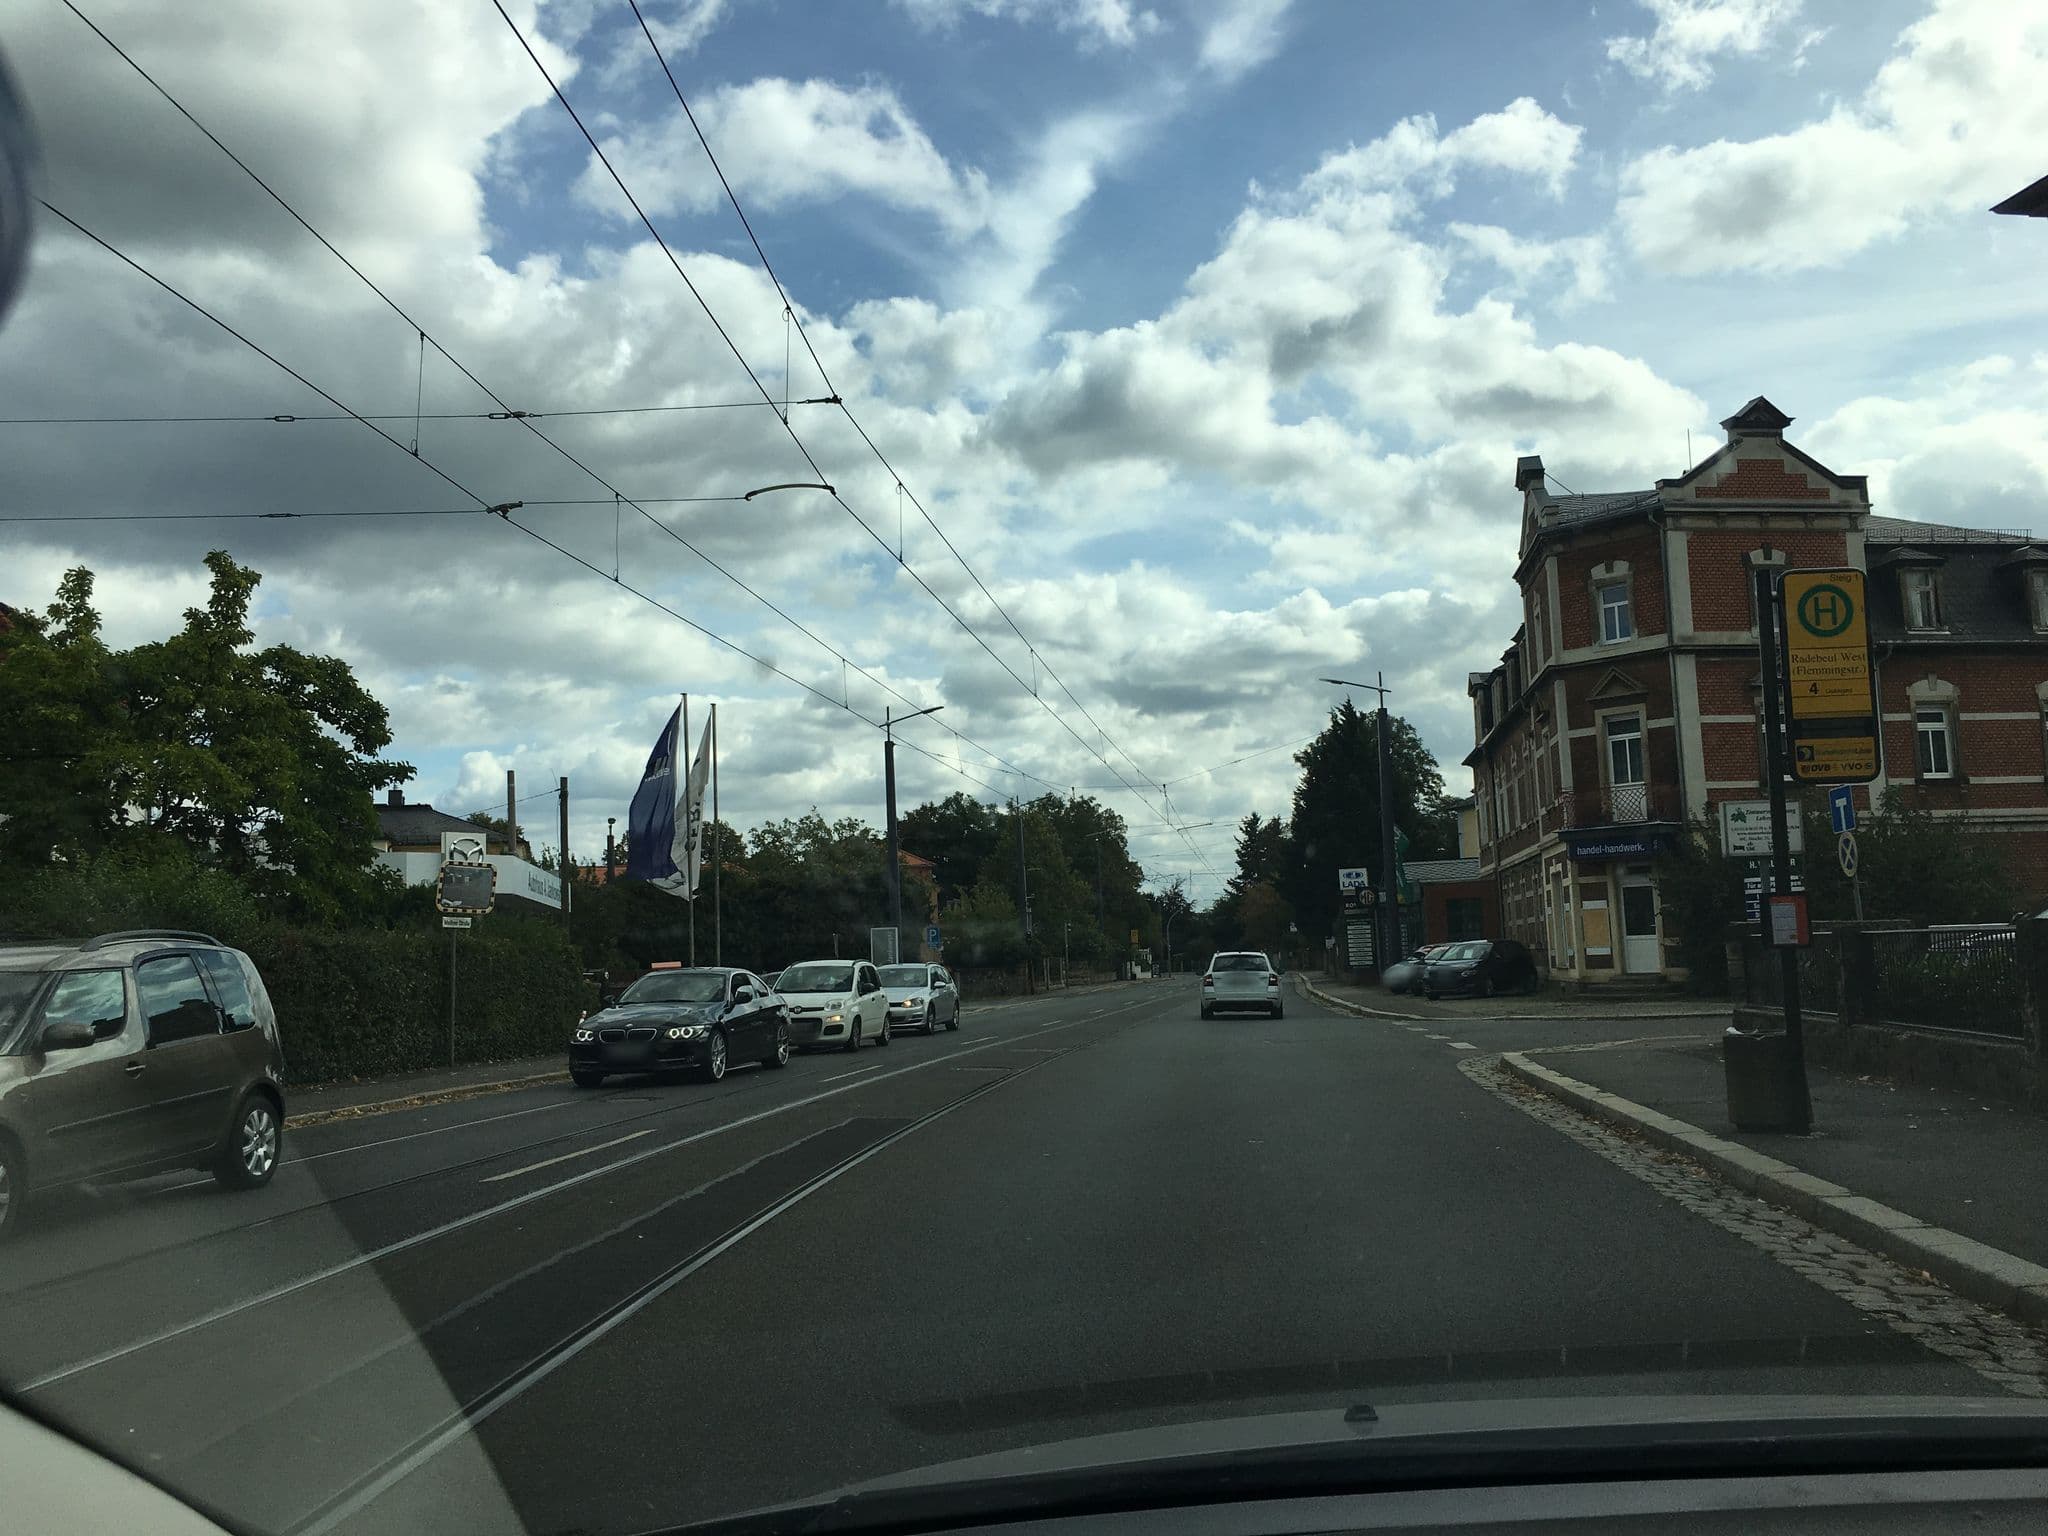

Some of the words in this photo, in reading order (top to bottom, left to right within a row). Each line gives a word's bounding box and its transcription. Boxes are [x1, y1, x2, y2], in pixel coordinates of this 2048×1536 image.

[1813, 596, 1838, 626] H
[1791, 653, 1837, 664] Radebeul
[1839, 652, 1866, 662] West
[1791, 664, 1867, 676] (Flemmingstr.)
[1809, 682, 1819, 695] 4
[1342, 880, 1365, 888] LADA
[929, 929, 937, 942] P
